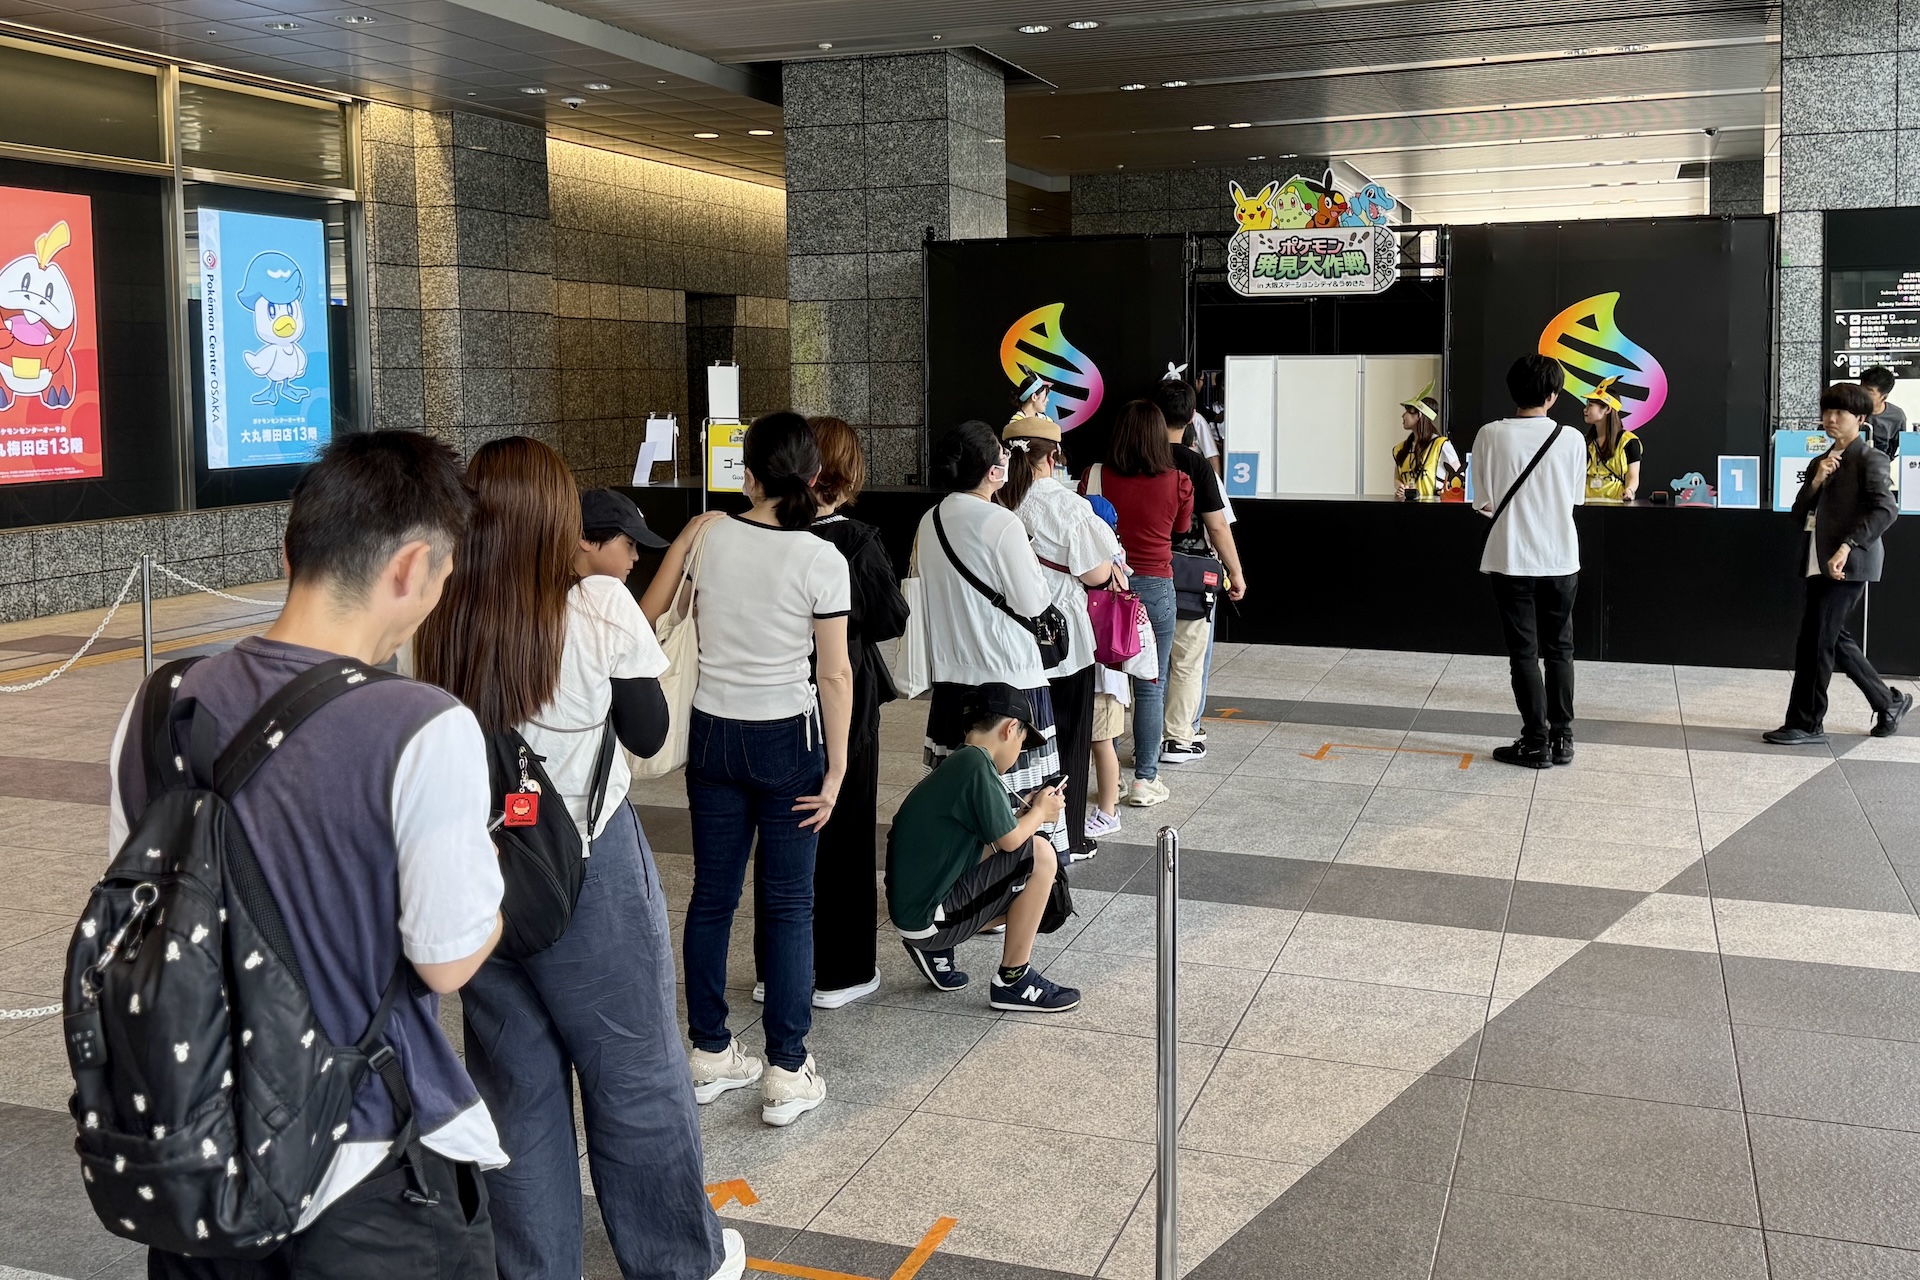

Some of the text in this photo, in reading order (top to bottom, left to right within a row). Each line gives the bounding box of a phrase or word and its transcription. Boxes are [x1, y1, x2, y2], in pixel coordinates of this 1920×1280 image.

[1279, 236, 1344, 255] ポケモン
[1253, 250, 1371, 280] 発見大作戦
[206, 274, 220, 423] Pokémon Center OSAKA
[0, 425, 67, 436] ケモンセンターオーサカ
[240, 426, 318, 443] 大丸梅田店13階
[723, 458, 744, 469] ゴー
[1232, 462, 1251, 484] 3
[1730, 469, 1743, 492] 1
[1021, 984, 1043, 1002] N
